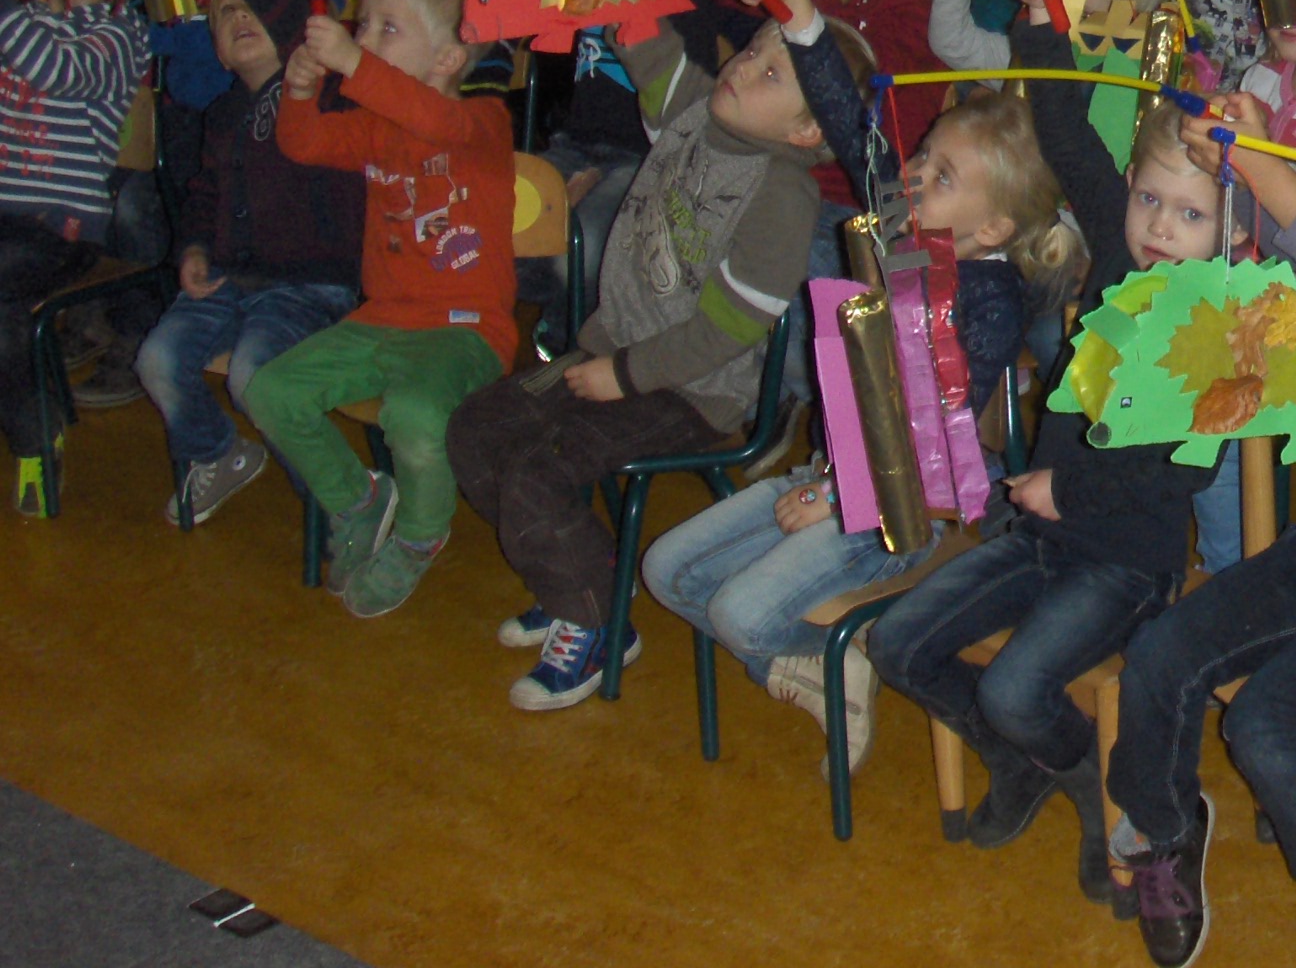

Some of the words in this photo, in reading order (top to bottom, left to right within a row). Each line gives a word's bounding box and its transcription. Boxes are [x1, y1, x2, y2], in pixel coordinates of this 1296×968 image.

[435, 226, 458, 255] LONDON
[458, 225, 476, 236] TRIP
[450, 249, 480, 270] GLOBAL
